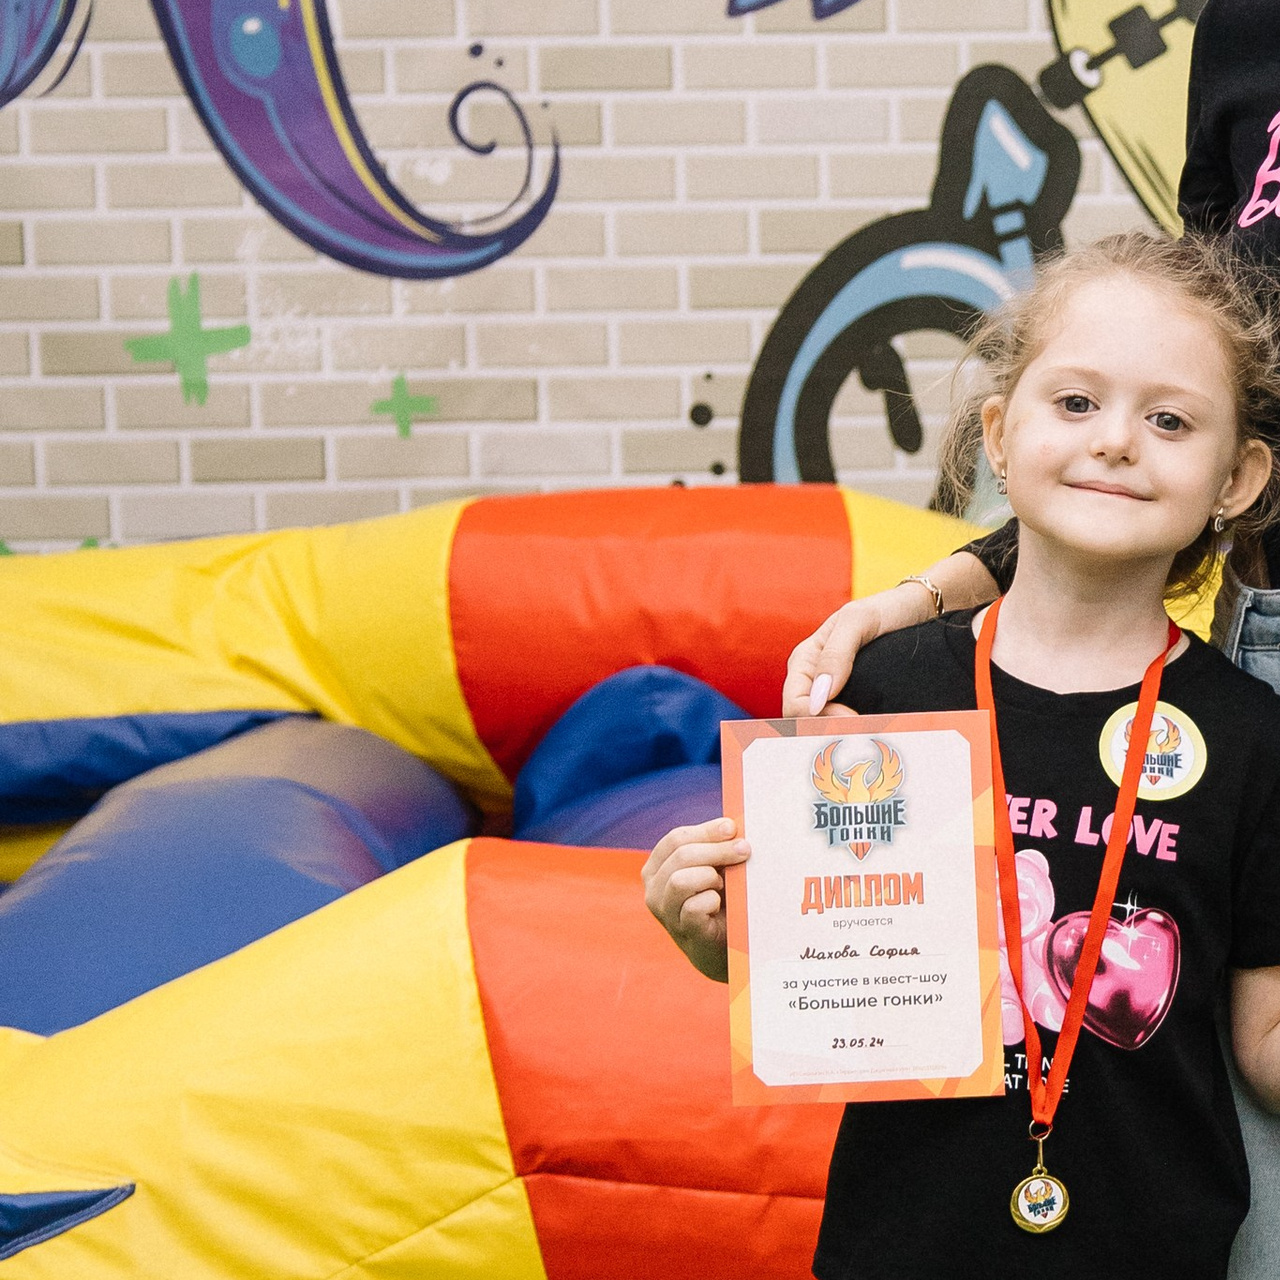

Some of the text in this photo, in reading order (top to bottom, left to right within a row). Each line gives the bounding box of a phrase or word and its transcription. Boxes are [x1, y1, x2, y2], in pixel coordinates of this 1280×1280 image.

[1141, 766, 1174, 779] ОНКИ
[813, 799, 906, 829] БОЛЬШИЕ
[829, 825, 891, 845] ГОНКИ
[801, 872, 925, 915] ДИПЛОМ
[833, 917, 893, 930] вручается
[800, 944, 921, 960] Махова София
[782, 973, 947, 991] за участие в квест-шоу
[788, 993, 943, 1011] «Большие гонки»
[832, 1037, 884, 1049] 23.05.24
